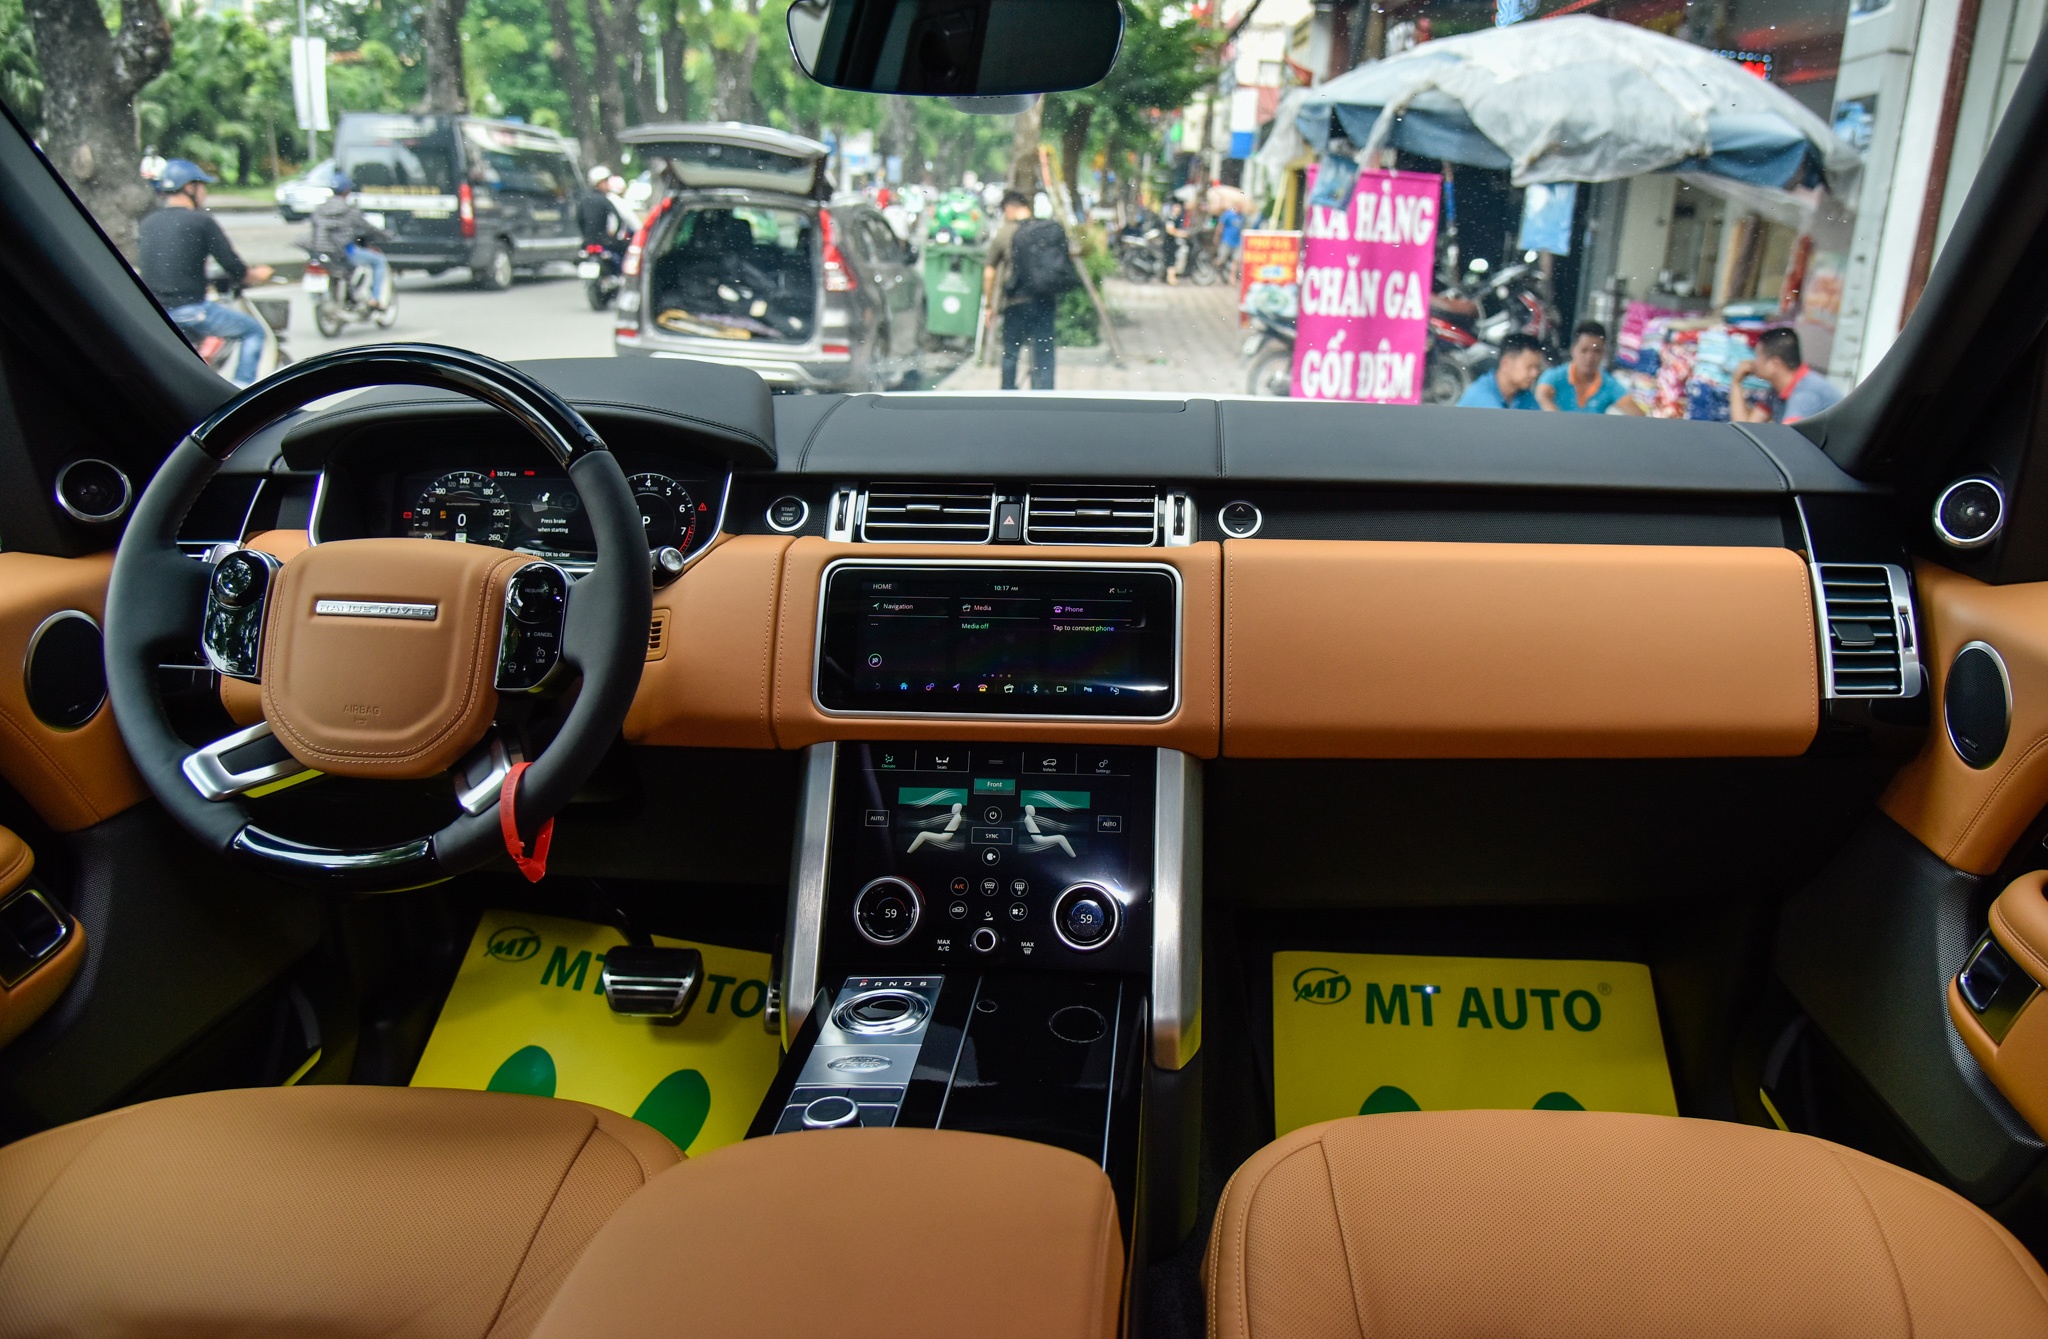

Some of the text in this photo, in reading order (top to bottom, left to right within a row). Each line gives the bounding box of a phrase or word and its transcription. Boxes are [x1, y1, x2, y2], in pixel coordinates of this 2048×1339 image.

[1301, 253, 1425, 320] CHĂN GA
[1300, 329, 1355, 399] GỐI
[666, 488, 672, 496] 5
[679, 504, 686, 513] 6
[457, 513, 467, 526] 0
[642, 516, 651, 528] P
[680, 527, 687, 535] 7
[320, 604, 432, 616] RANGE ROVER
[883, 603, 914, 611] Navigation
[344, 704, 381, 716] AIRBAG
[884, 909, 897, 918] 59
[1018, 908, 1024, 916] 2
[1080, 914, 1093, 924] 59
[1294, 974, 1347, 1001] MT
[1365, 982, 1601, 1032] MT AUTO
